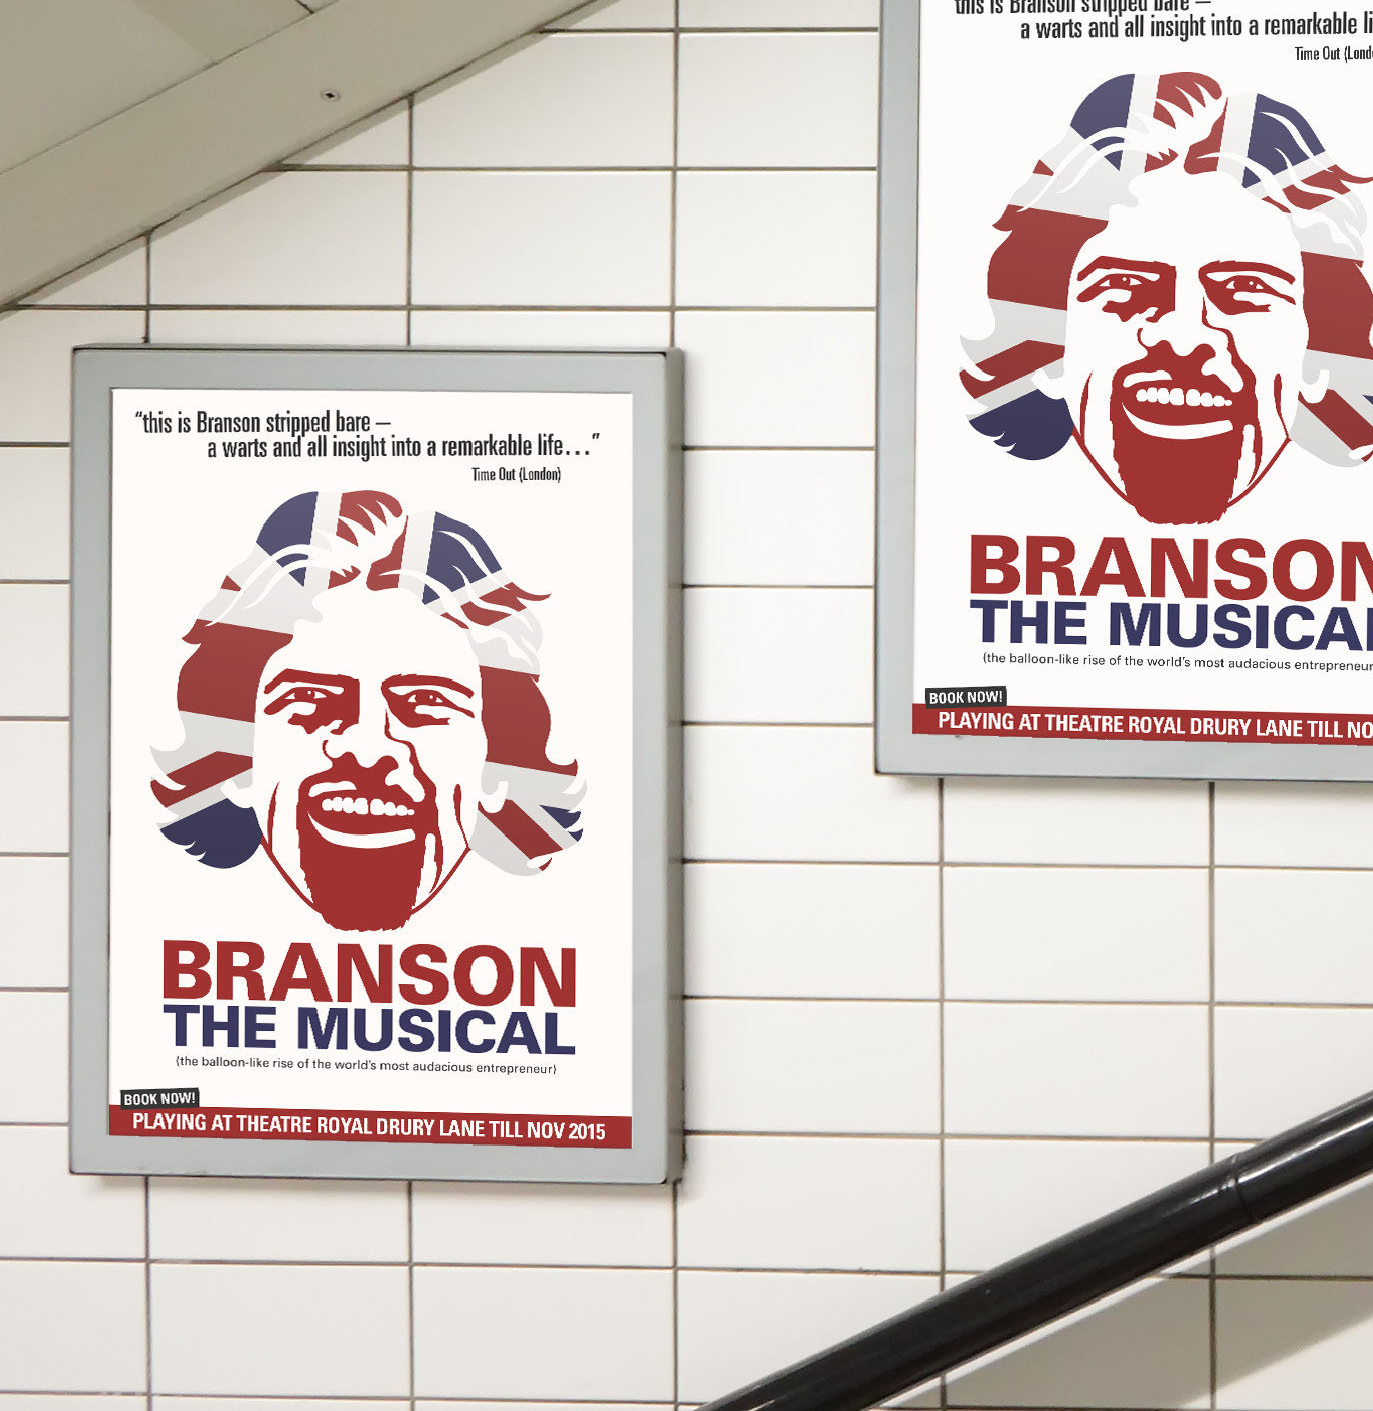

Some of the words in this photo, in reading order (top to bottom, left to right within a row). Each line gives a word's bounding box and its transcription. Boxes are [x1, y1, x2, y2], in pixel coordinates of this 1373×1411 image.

[1294, 46, 1320, 61] Time
[1322, 45, 1341, 61] Out
[178, 410, 192, 434] is
[197, 410, 261, 434] Branson
[266, 409, 331, 436] stripped
[336, 409, 371, 433] bare
[207, 441, 217, 458] a
[221, 438, 268, 458] warts
[272, 434, 302, 458] and
[306, 434, 328, 458] all
[332, 434, 388, 463] insight
[391, 434, 422, 457] into
[426, 440, 437, 457] a
[441, 433, 533, 457] remarkable
[470, 466, 496, 482] Time
[498, 466, 516, 481] Out
[518, 466, 562, 484] (London)
[969, 599, 1087, 645] THE
[939, 711, 1014, 730] PLAYING
[1018, 713, 1042, 731] AT
[1044, 713, 1124, 733] THEATRE
[1128, 715, 1186, 735] ROYAL
[1190, 717, 1252, 736] DRURY
[1256, 718, 1303, 737] LANE
[1306, 720, 1344, 738] TILL
[163, 939, 577, 1008] BRANSON
[163, 1004, 277, 1049] THE
[297, 1006, 576, 1055] MUSICAL
[124, 1093, 158, 1106] BOOK
[160, 1091, 196, 1105] NOW!
[132, 1112, 207, 1131] PLAYING
[210, 1114, 233, 1132] AT
[235, 1114, 312, 1133] THEATRE
[317, 1116, 373, 1135] ROYAL
[376, 1117, 435, 1136] DRURY
[439, 1119, 486, 1137] LANE
[488, 1120, 524, 1138] TILL
[527, 1121, 566, 1139] NOV
[568, 1122, 606, 1140] 2015
